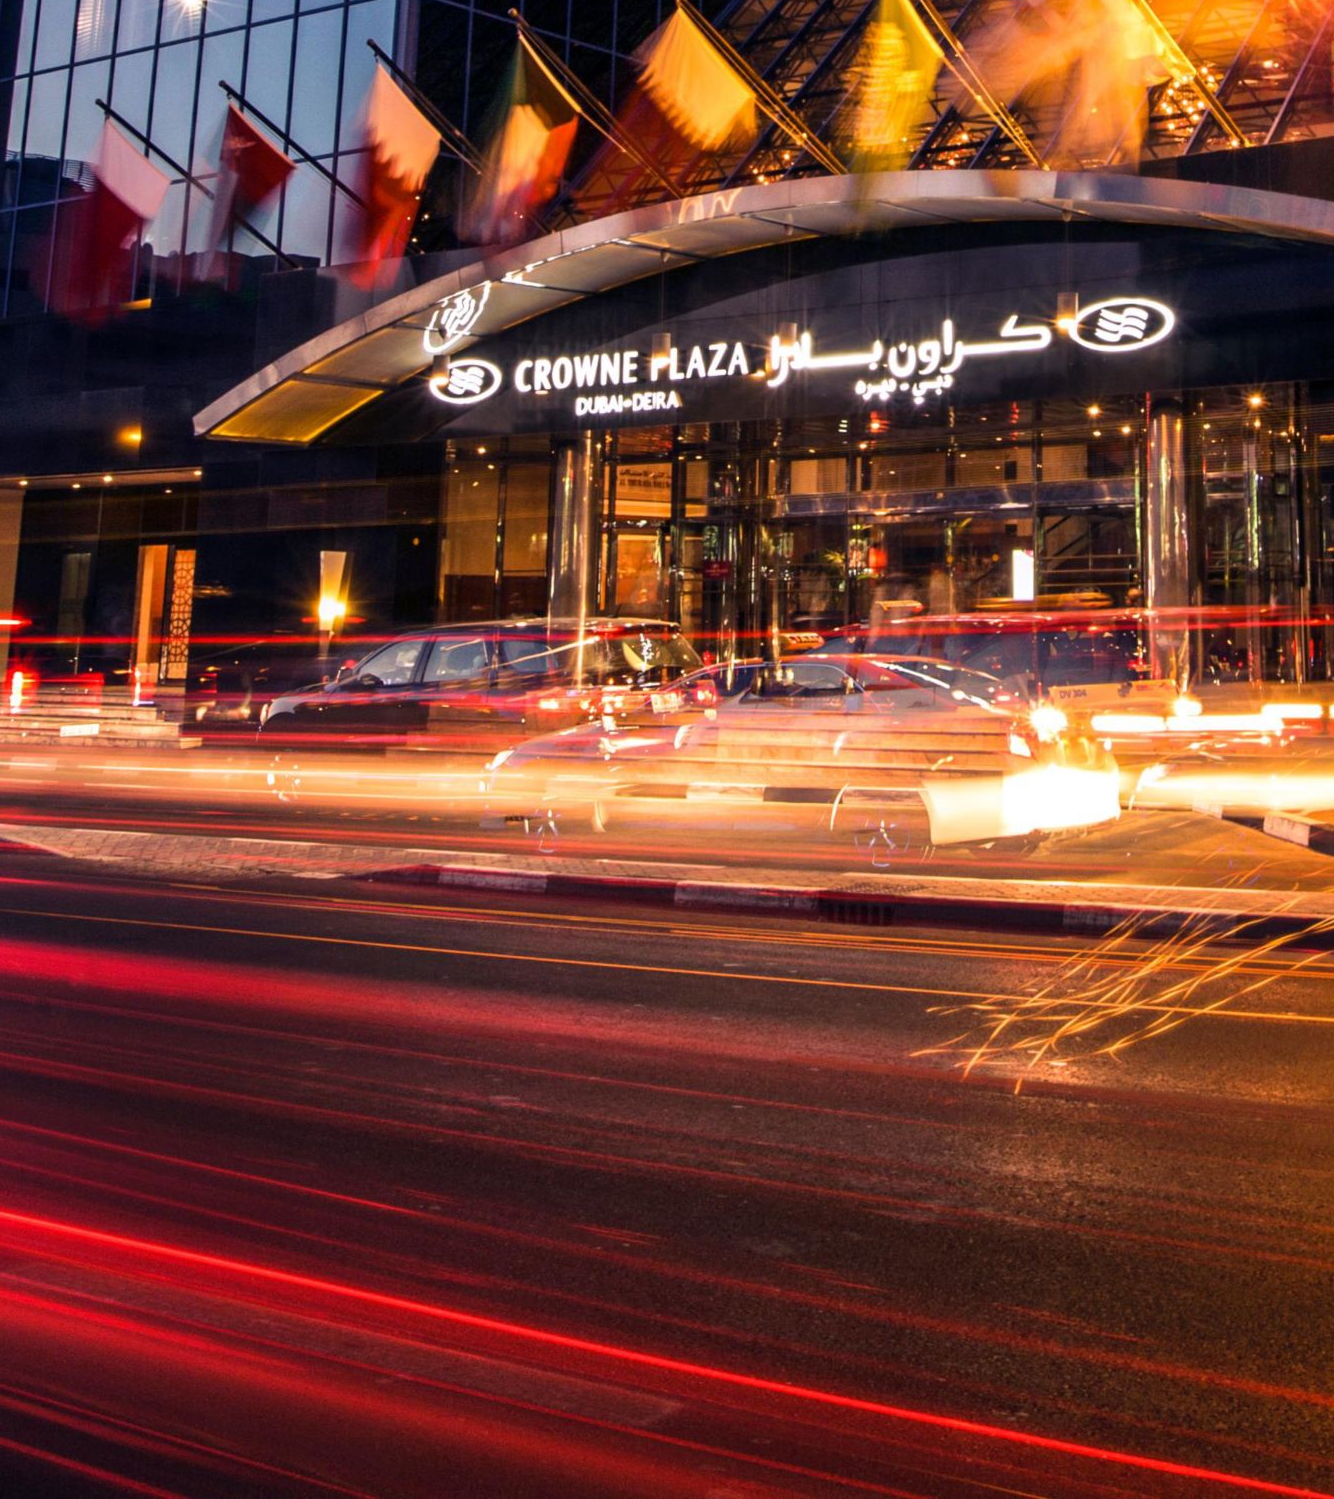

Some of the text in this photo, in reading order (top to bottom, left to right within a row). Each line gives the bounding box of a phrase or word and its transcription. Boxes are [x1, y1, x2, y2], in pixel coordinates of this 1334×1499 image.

[513, 341, 750, 394] CROWNE PLAZA
[887, 314, 1054, 378] كراون
